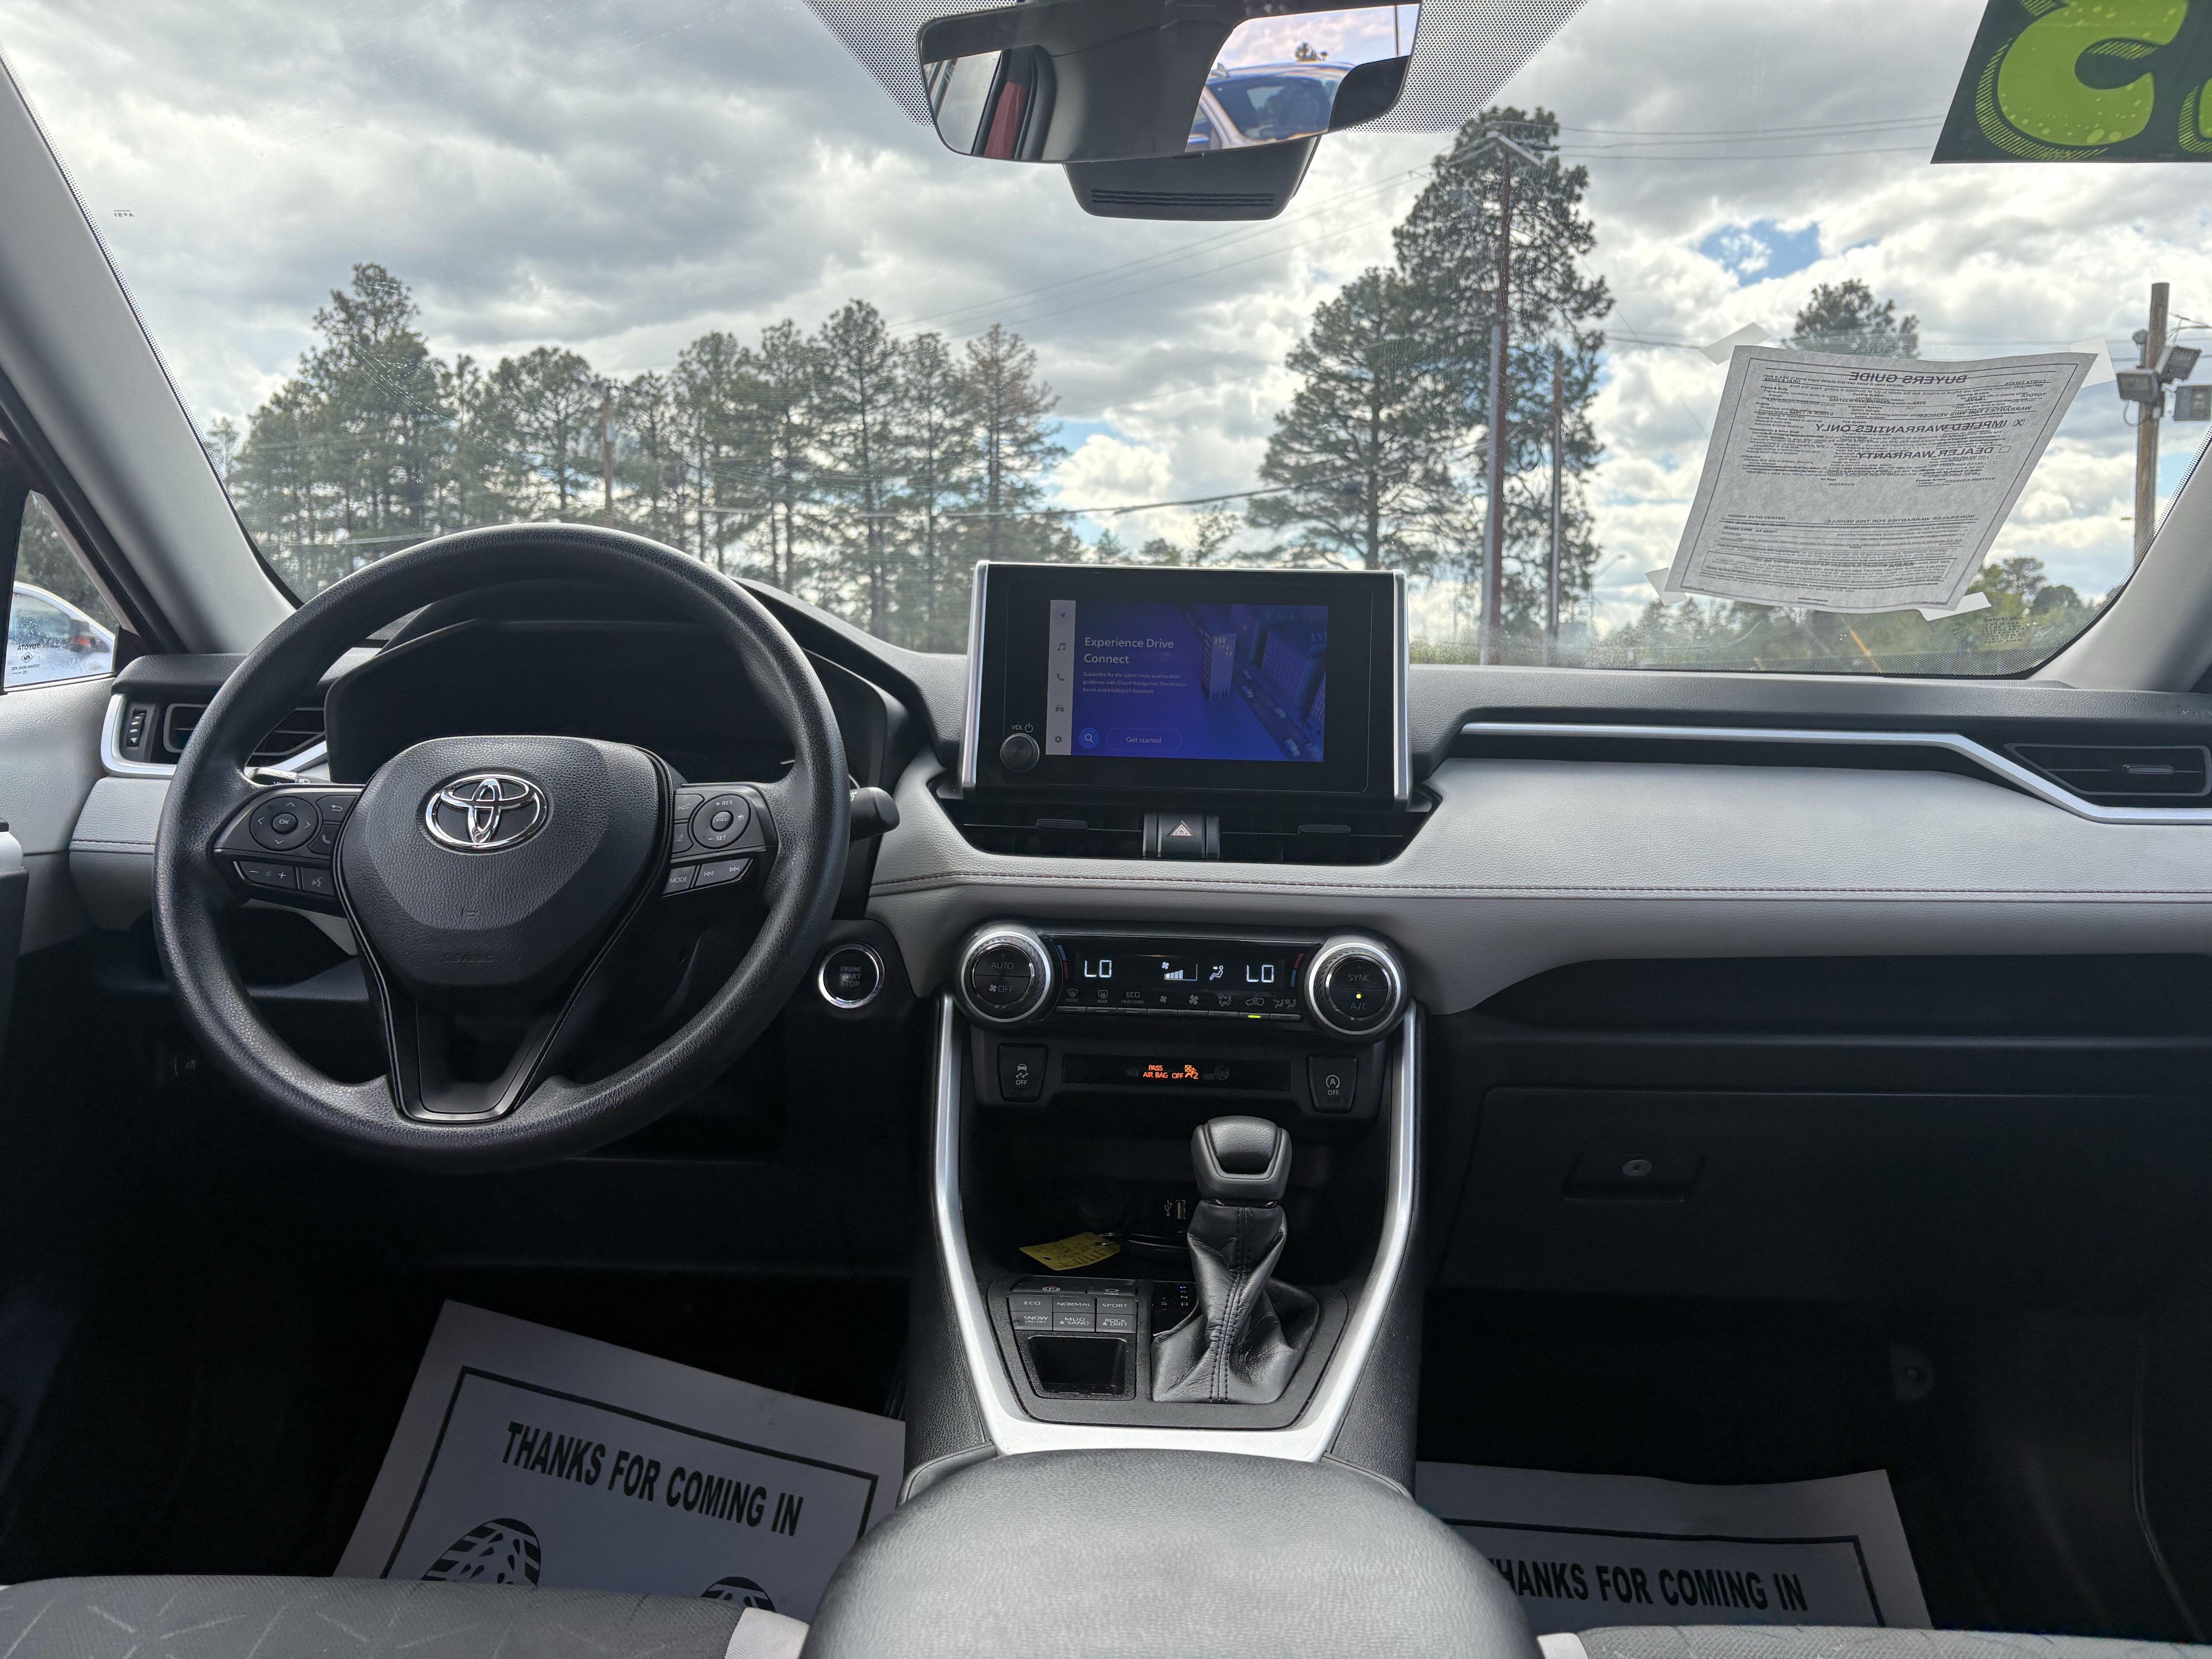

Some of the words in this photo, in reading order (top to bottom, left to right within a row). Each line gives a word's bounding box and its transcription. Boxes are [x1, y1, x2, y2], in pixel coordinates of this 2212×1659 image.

[1085, 637, 1144, 649] Experience
[1146, 639, 1174, 648] Drive
[1084, 654, 1130, 664] Connect
[1084, 960, 1112, 978] LO
[1246, 964, 1275, 983] LO
[1348, 974, 1370, 982] SYNC
[502, 1421, 606, 1486] THANKS
[608, 1450, 661, 1501] FOR
[666, 1467, 768, 1527] COMING
[771, 1492, 804, 1537] IN
[1595, 1565, 1654, 1604] FOR
[1659, 1568, 1769, 1610] COMING
[1773, 1573, 1808, 1612] IN
